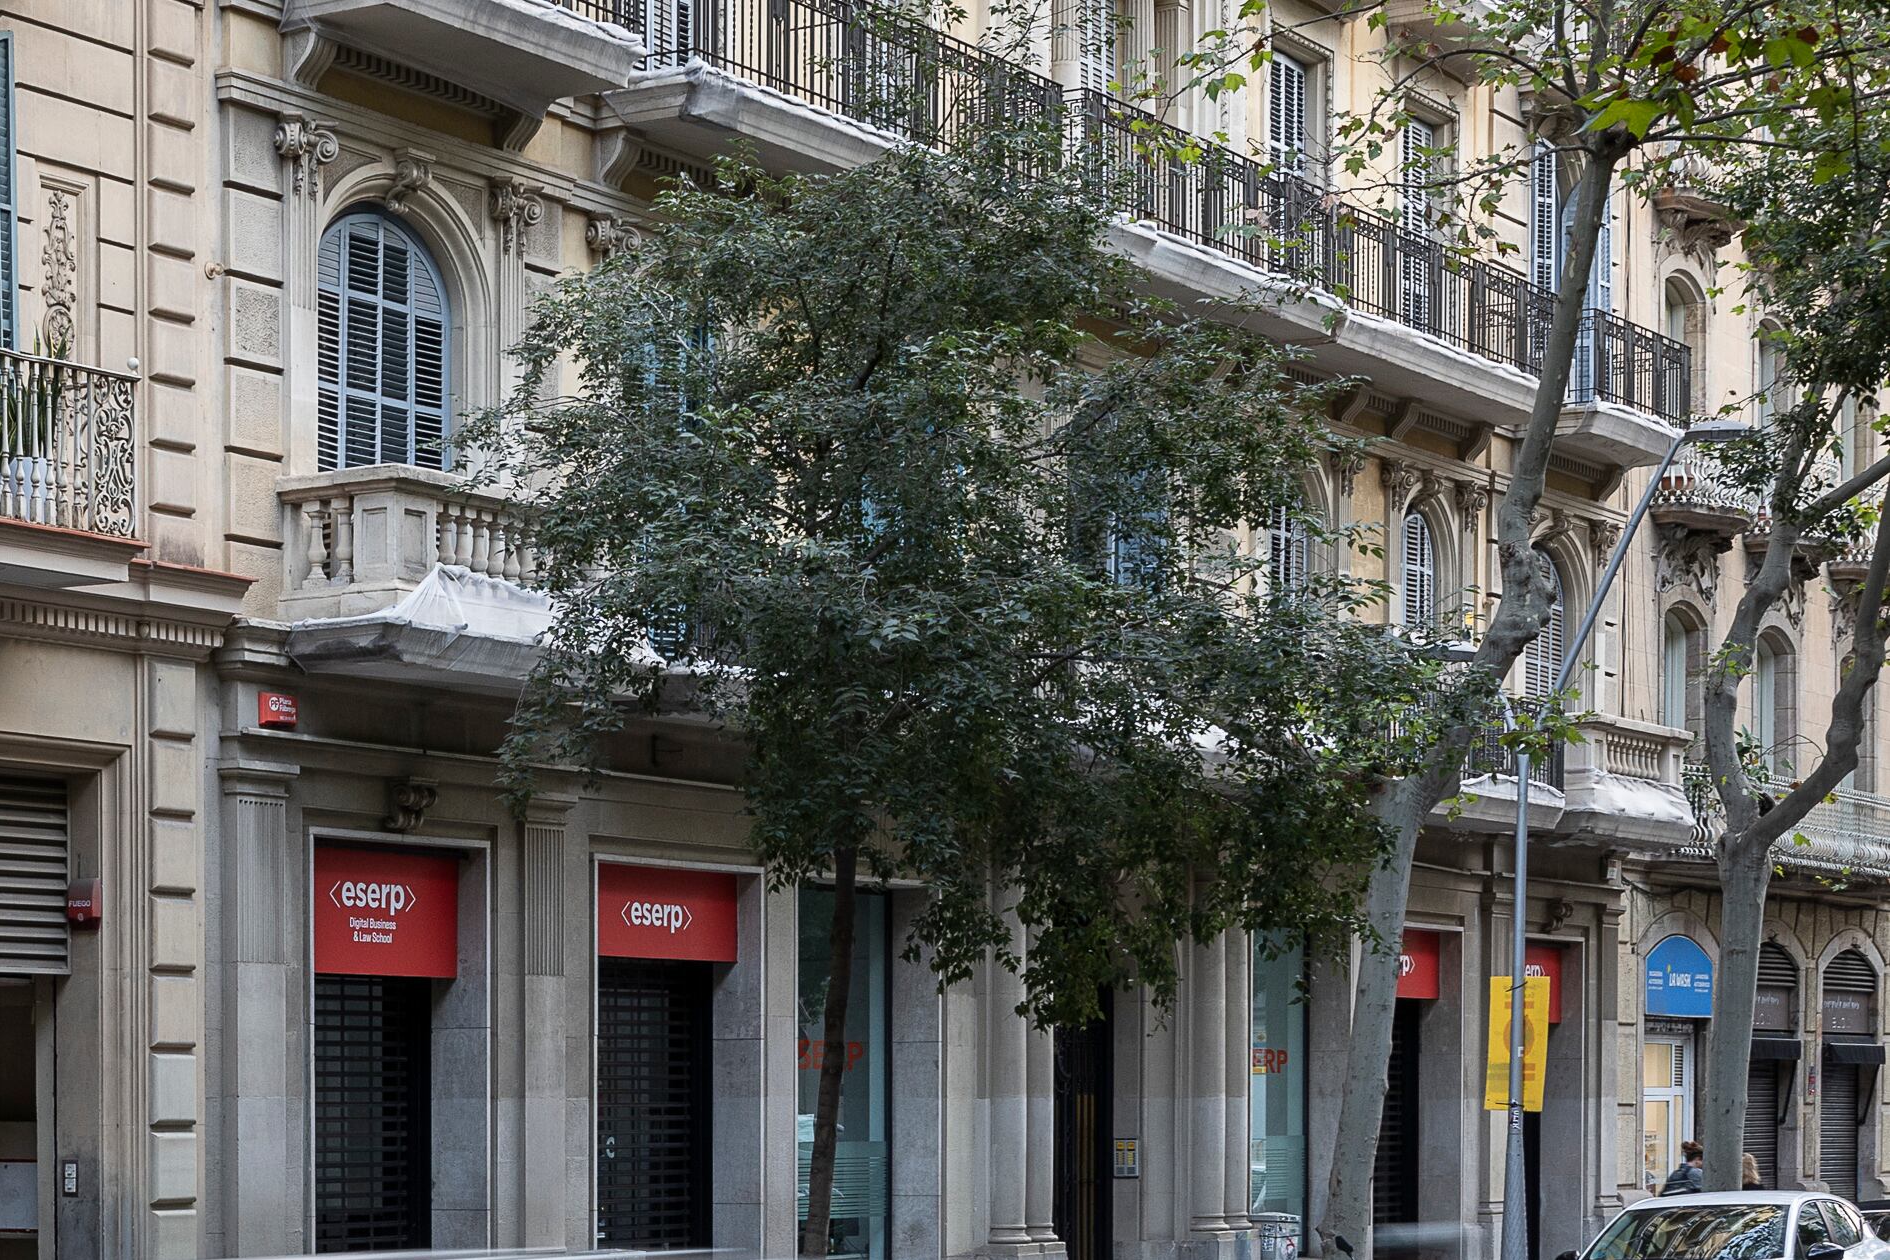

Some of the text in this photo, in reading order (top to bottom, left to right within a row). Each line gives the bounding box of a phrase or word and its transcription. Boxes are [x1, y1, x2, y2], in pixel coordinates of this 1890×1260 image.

[349, 916, 397, 930] Digital Business
[353, 930, 393, 943] & Law School
